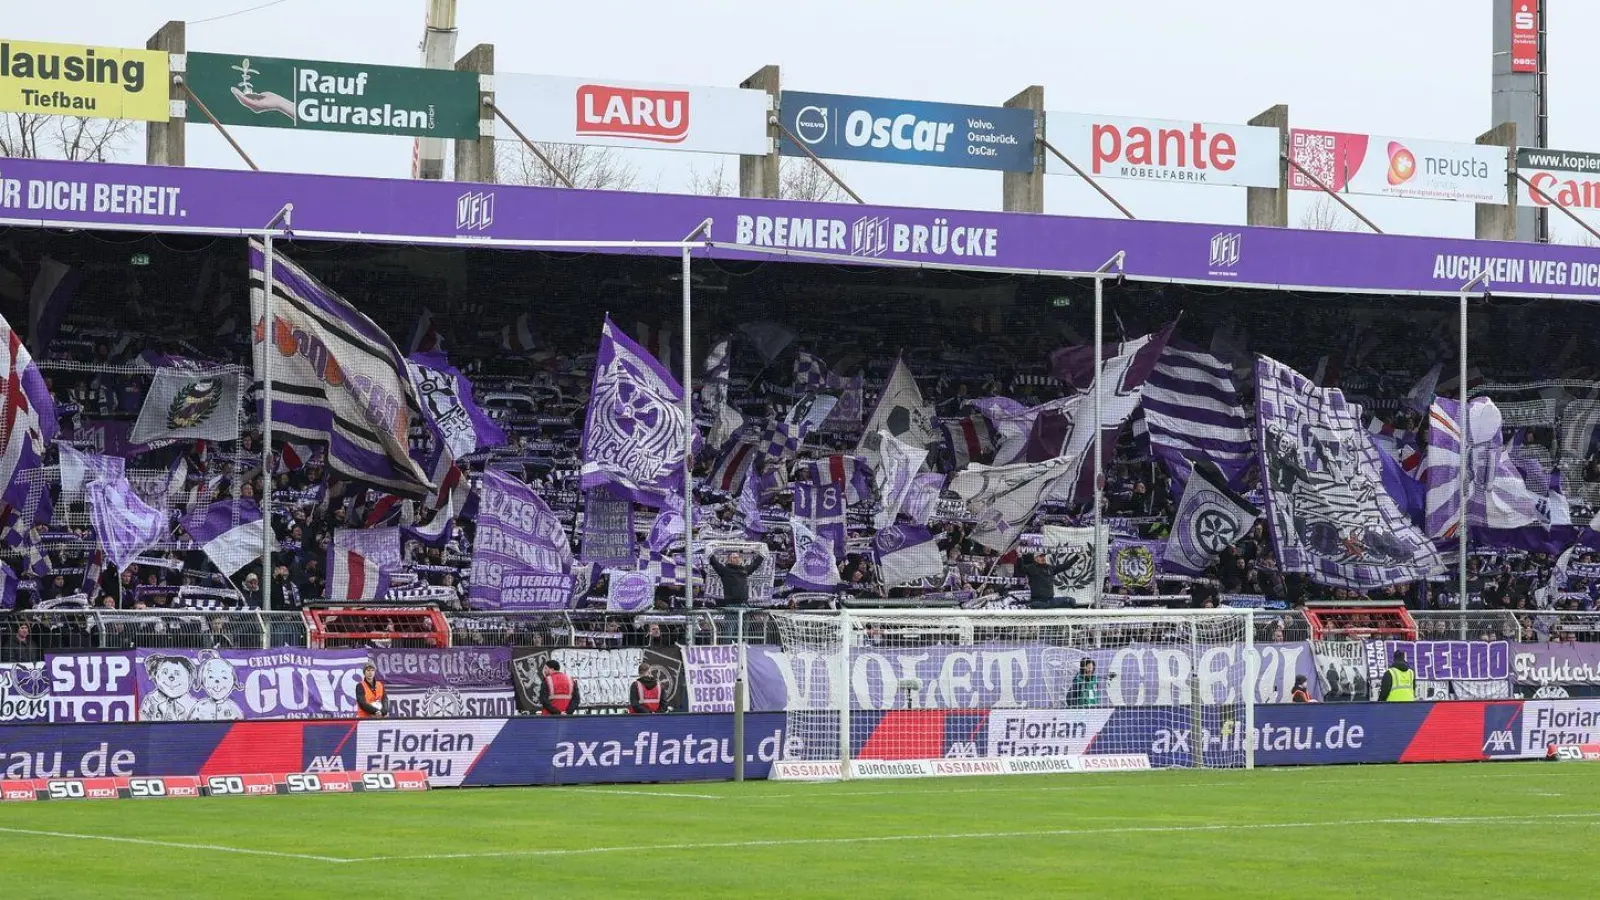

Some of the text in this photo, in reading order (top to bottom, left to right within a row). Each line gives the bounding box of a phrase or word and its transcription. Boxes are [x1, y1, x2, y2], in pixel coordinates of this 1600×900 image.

[299, 68, 368, 96] Rauf
[21, 89, 96, 110] Tiefbau
[297, 98, 428, 129] Güraslan
[583, 94, 682, 129] LARU
[967, 118, 994, 130] Volvo.
[967, 131, 1018, 145] Osnabrück.
[1091, 122, 1236, 175] pante
[967, 145, 998, 157] OsCar.
[1120, 166, 1207, 182] MÖBELFABRIK
[1425, 157, 1488, 179] neusta
[0, 172, 187, 217] R DICH BEREIT.
[458, 193, 493, 228] VFL
[736, 213, 847, 250] BREMER
[893, 218, 998, 257] BRÜCKE
[1210, 233, 1240, 265] VFL
[1433, 254, 1481, 280] AUCH
[1485, 257, 1525, 283] KEIN
[1529, 260, 1567, 285] WEG
[521, 575, 562, 588] VEREIN
[248, 653, 313, 668] CERVISIAM
[687, 646, 739, 664] ULTRAS
[1367, 642, 1378, 678] ULTRA
[52, 656, 130, 692] SUP
[763, 648, 1028, 710] VIOLET
[245, 667, 365, 714] GUYS
[388, 699, 420, 717] ASE
[1004, 717, 1087, 740] Florian
[377, 728, 474, 753] Florian
[552, 729, 805, 769] axa-flatau.de
[945, 742, 978, 758] AXA
[1482, 730, 1516, 751] AXA
[1557, 746, 1583, 760] SO
[305, 755, 345, 773] AXA
[366, 754, 452, 777] Flatau
[858, 762, 927, 775] BÜROMÖBEL
[936, 759, 1000, 774] ASSMANN
[1010, 759, 1073, 772] BÜROMÖBEL
[1084, 757, 1146, 769] ASSMANN
[49, 781, 115, 798] SO TECH
[132, 779, 196, 796] SO TECH
[209, 777, 273, 794] SO TECH
[287, 774, 349, 792] SO TECH
[363, 773, 396, 789] SO
[5, 790, 33, 799] TECH
